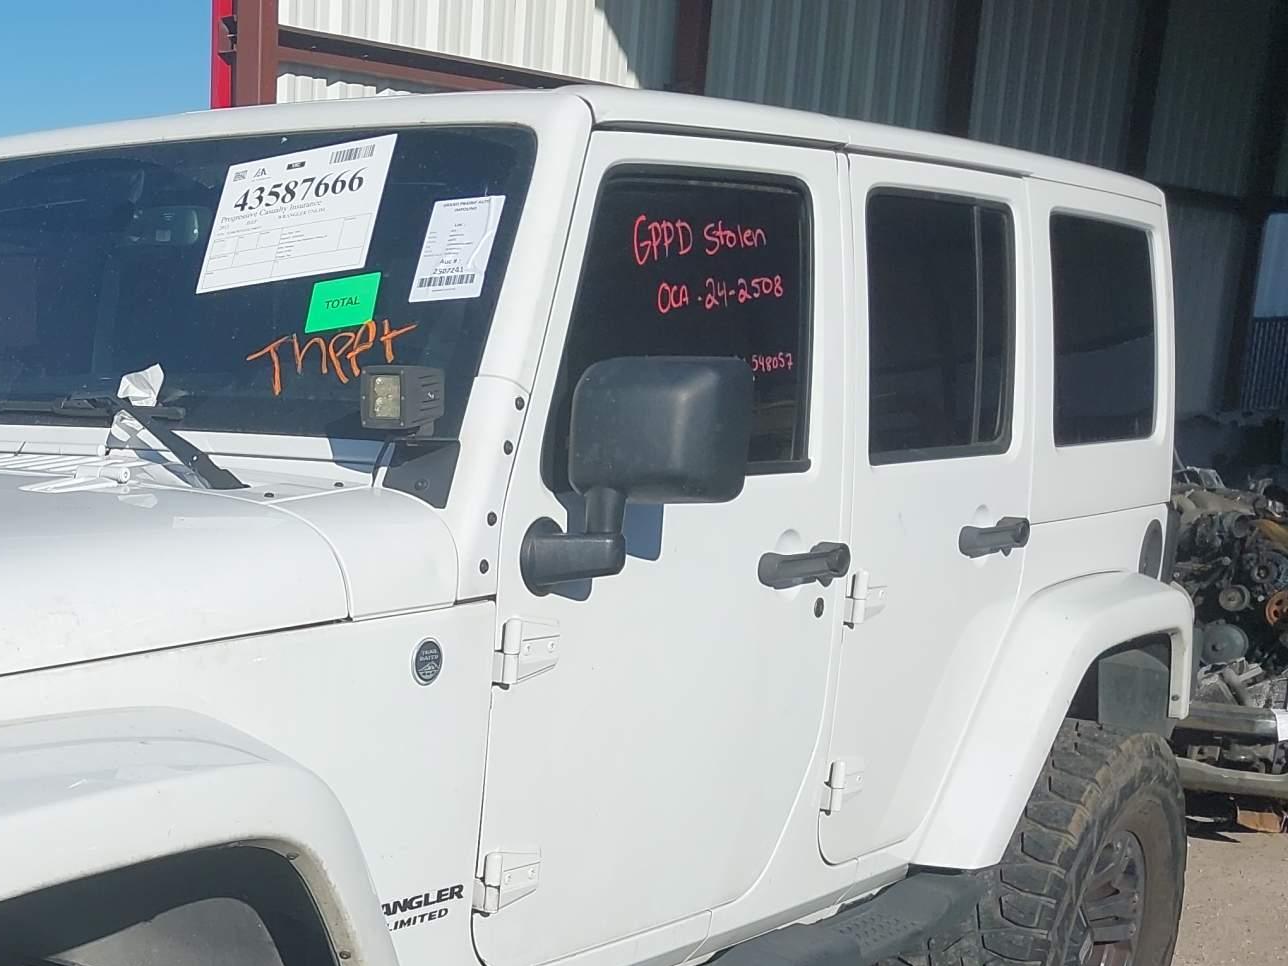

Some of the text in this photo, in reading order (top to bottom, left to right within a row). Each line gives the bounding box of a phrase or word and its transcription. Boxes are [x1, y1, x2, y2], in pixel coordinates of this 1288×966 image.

[234, 167, 368, 211] 43587666
[633, 214, 767, 265] GPPD Stolen
[324, 295, 361, 310] TOTAL
[381, 884, 464, 916] ANGLER
